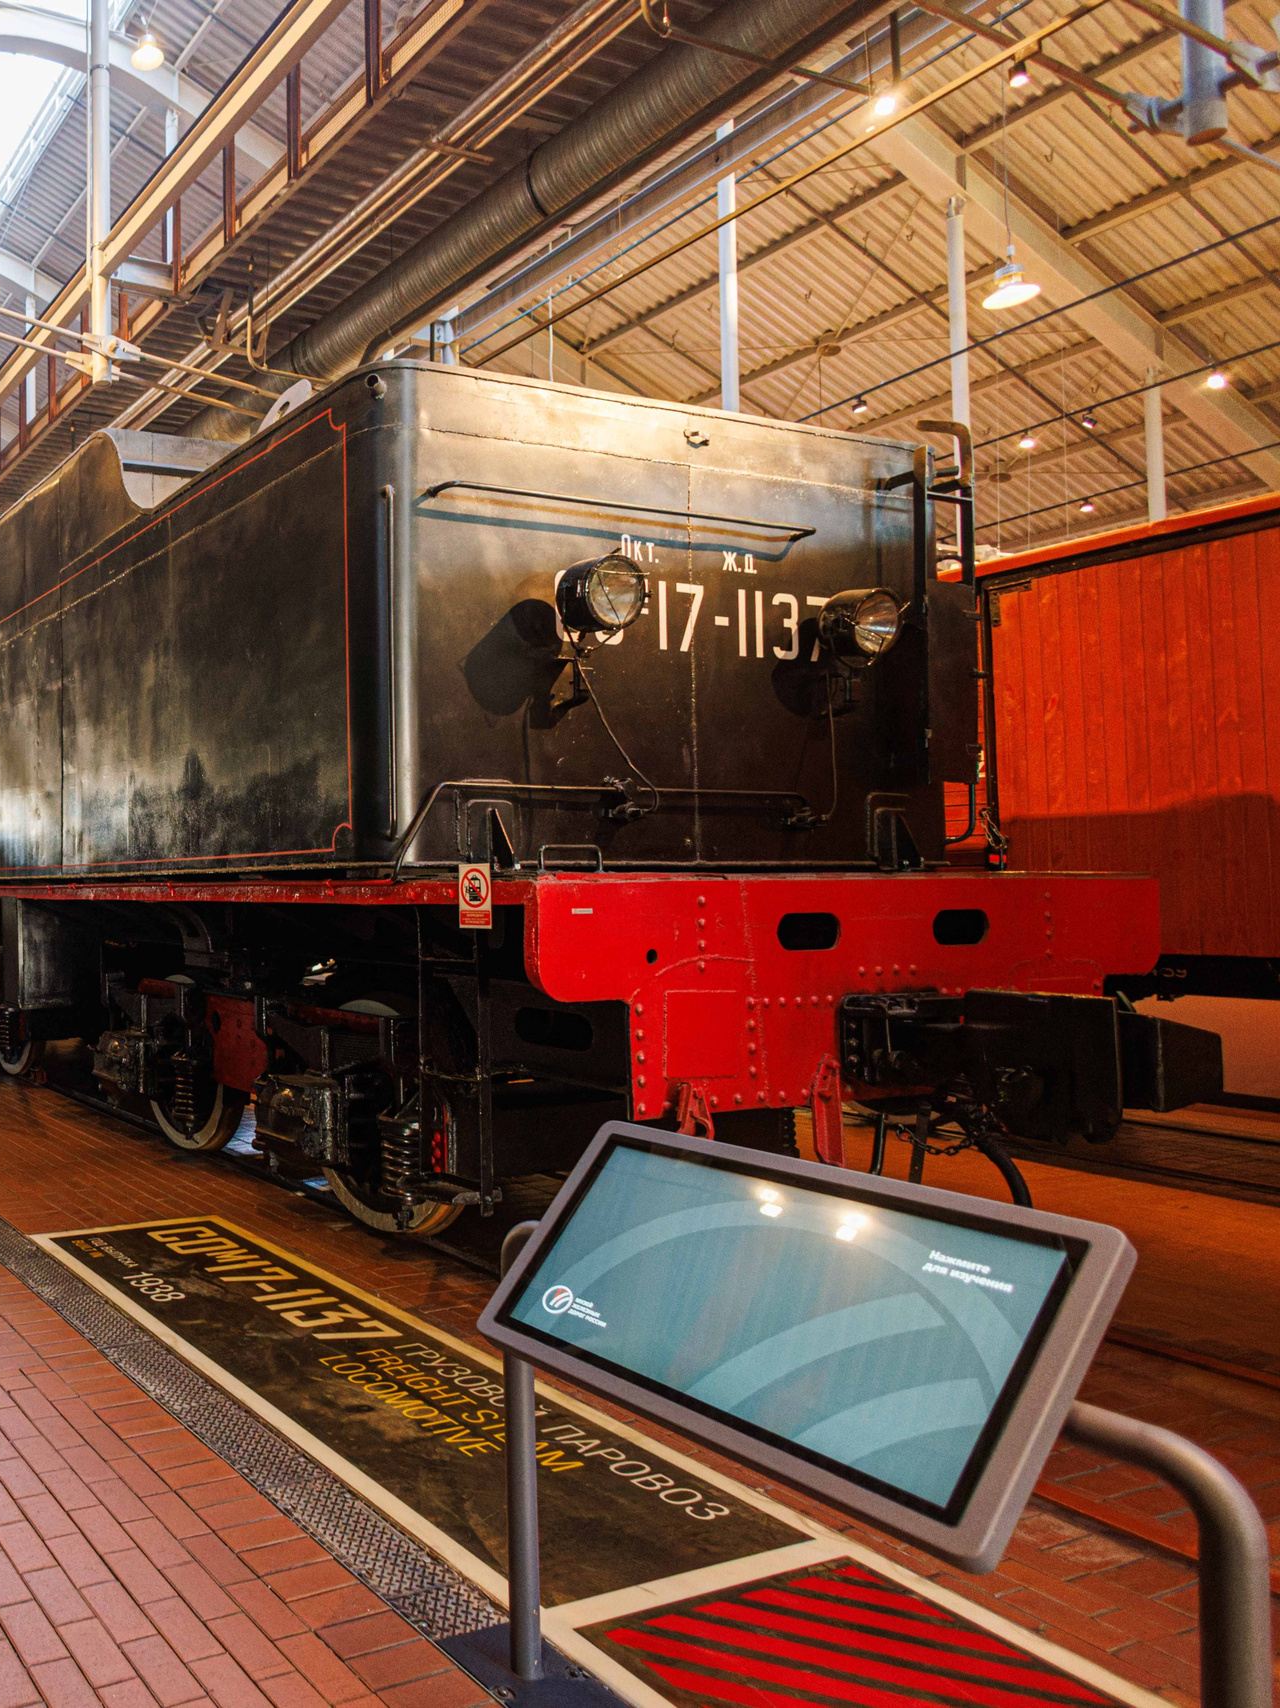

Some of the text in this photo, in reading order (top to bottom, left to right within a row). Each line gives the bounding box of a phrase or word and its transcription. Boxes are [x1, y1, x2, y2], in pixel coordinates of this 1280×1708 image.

[922, 1262, 949, 1275] для
[928, 1249, 992, 1275] Нажмите
[122, 1271, 186, 1302] 1938
[356, 1348, 478, 1407] FREIGHT
[318, 1354, 502, 1458] LOCOMOTIVE
[540, 1424, 730, 1521] ПАРОВОЗ
